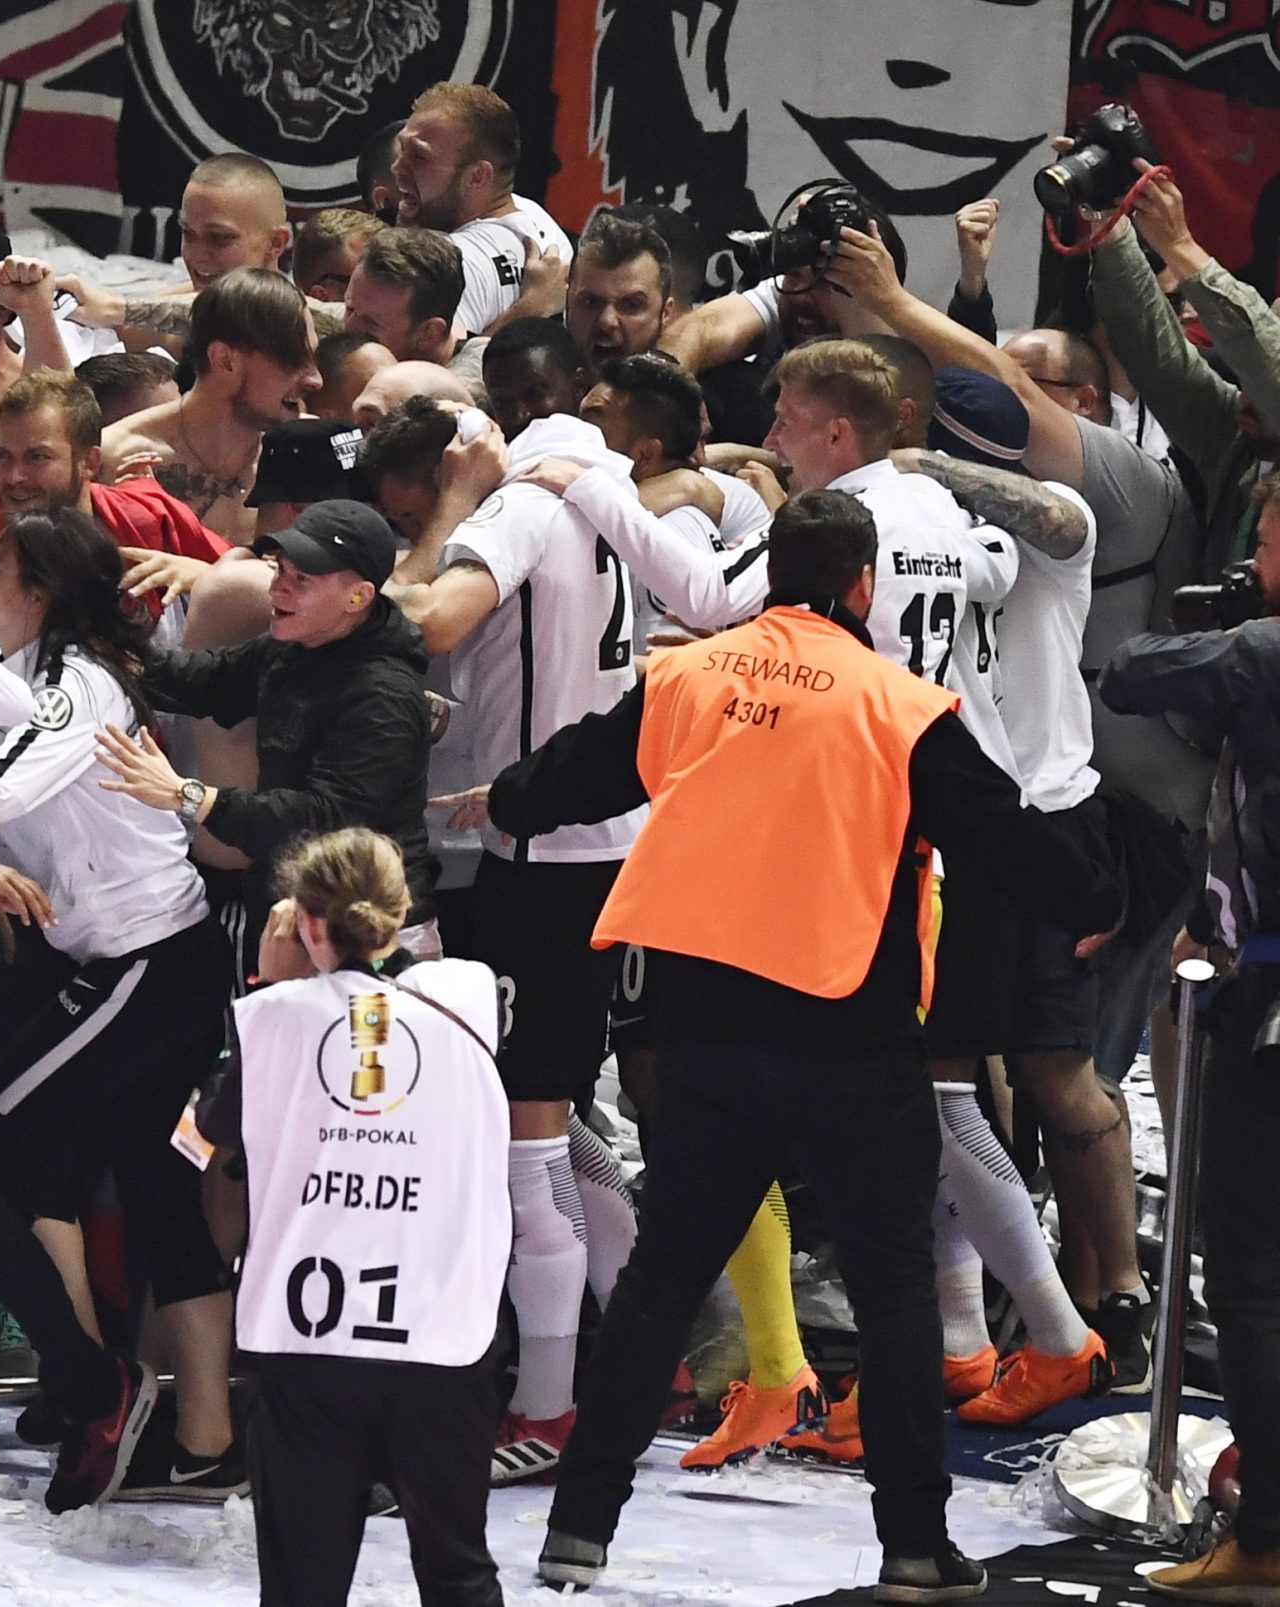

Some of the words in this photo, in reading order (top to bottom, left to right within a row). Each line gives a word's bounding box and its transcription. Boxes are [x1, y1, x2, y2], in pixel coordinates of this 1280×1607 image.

[703, 651, 835, 692] STEWARD
[723, 697, 780, 729] 4301
[319, 1127, 417, 1145] DFB-POKAL
[301, 1170, 421, 1212] DFB.DE
[286, 1256, 410, 1344] 01
